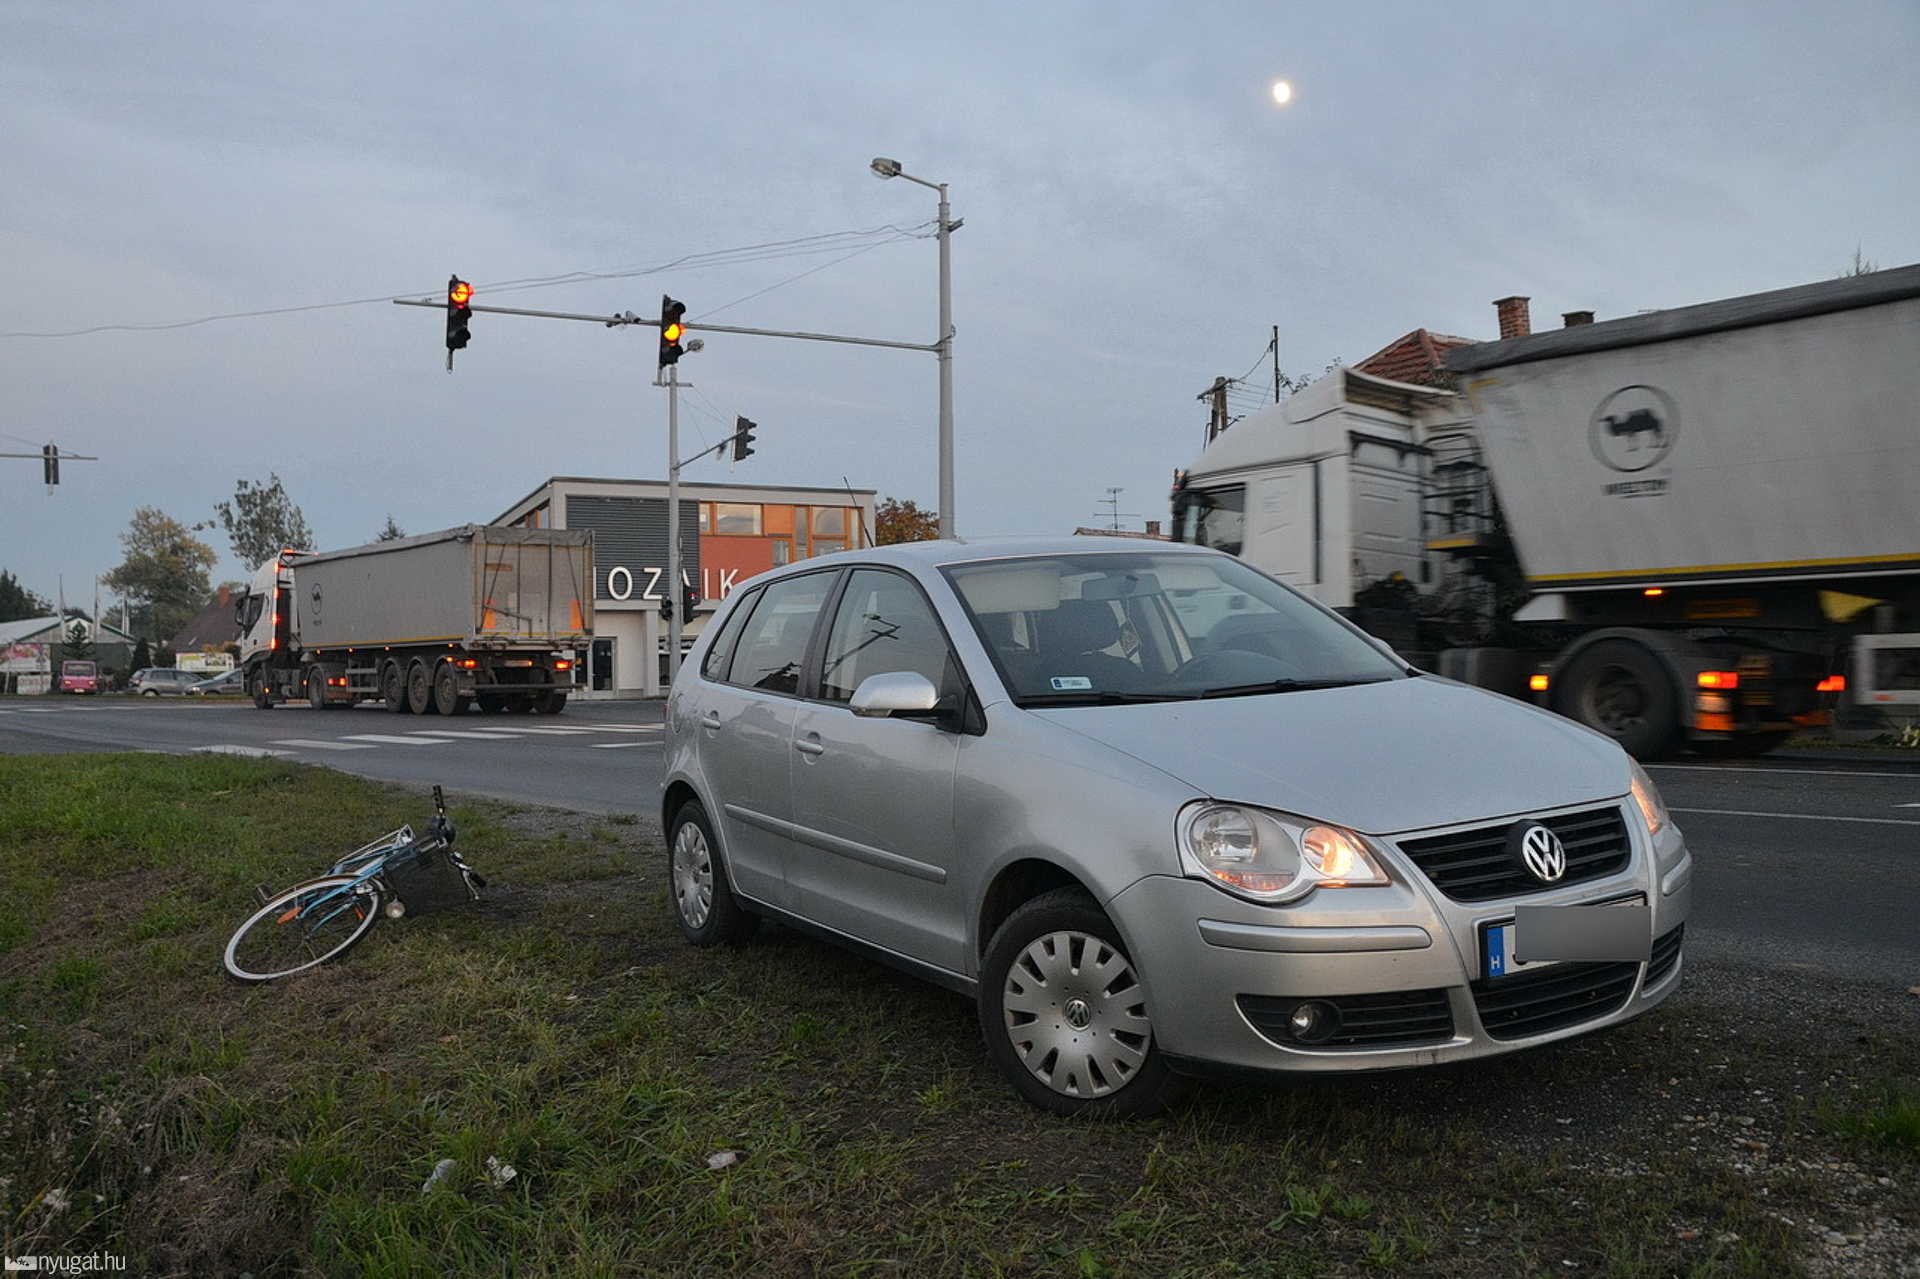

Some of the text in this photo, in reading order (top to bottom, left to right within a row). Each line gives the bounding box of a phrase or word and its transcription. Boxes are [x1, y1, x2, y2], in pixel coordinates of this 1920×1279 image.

[592, 565, 739, 600] OZIK
[1522, 826, 1566, 881] VW
[1490, 954, 1501, 970] H
